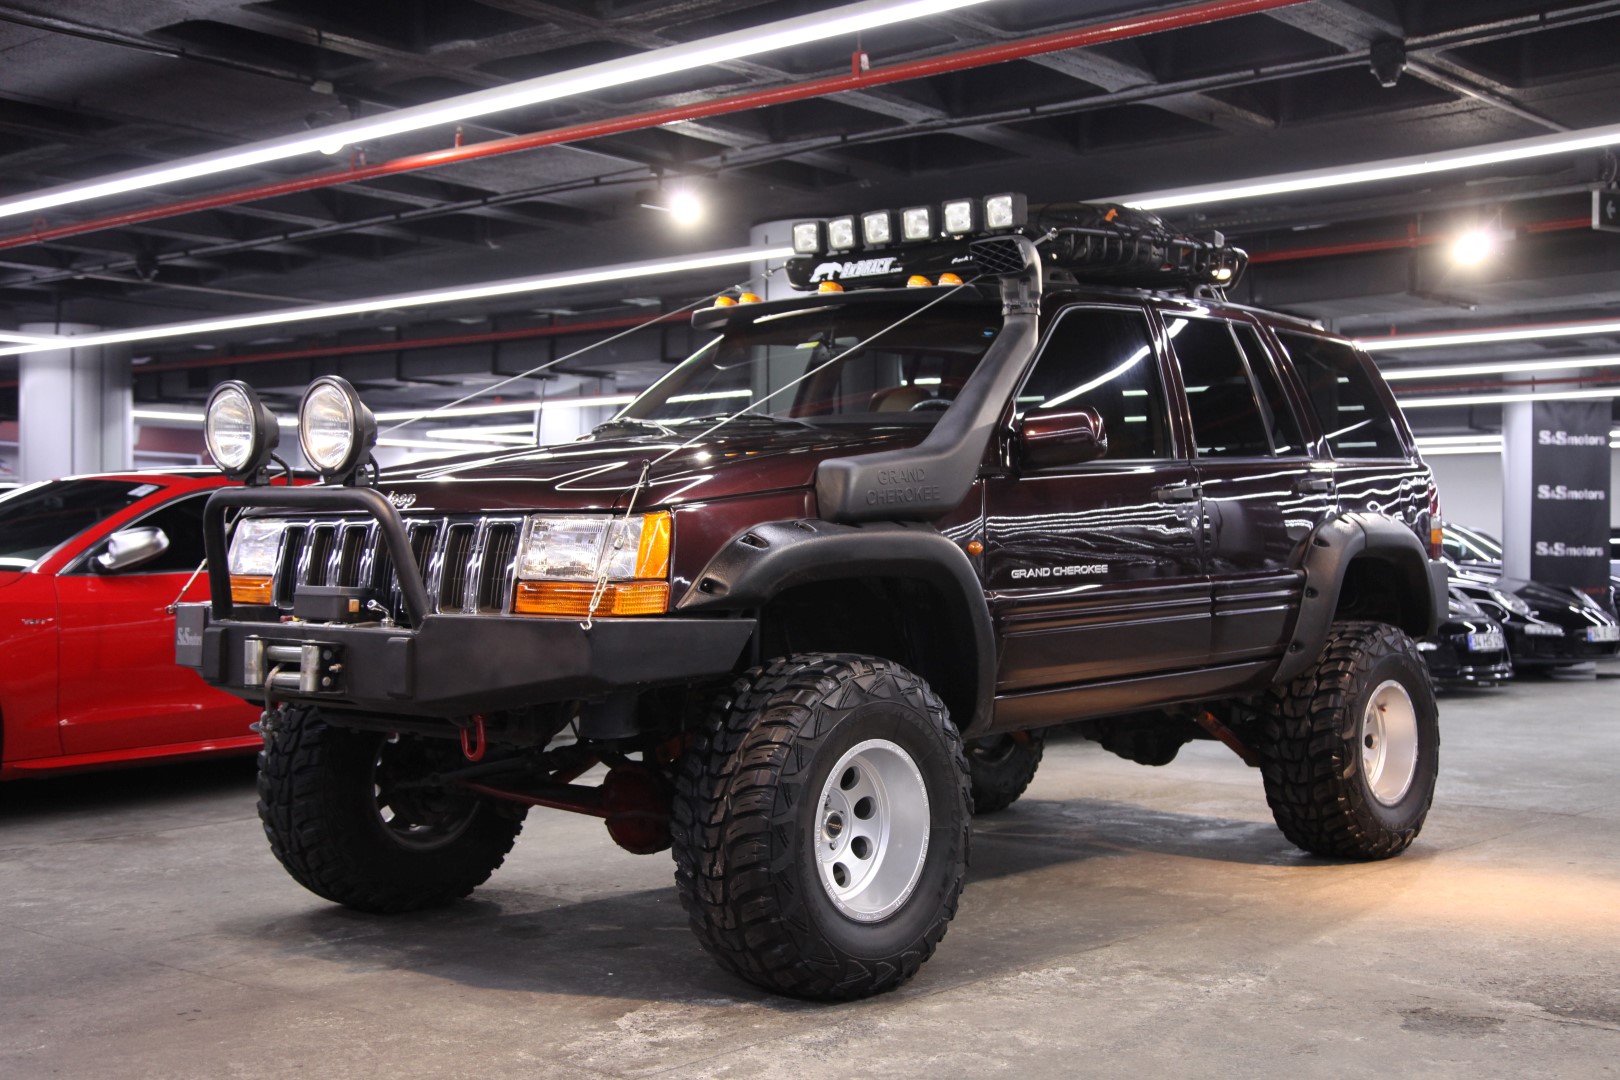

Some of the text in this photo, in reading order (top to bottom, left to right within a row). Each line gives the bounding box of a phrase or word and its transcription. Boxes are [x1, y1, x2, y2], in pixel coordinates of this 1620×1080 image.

[877, 468, 925, 485] GRAND
[866, 485, 941, 505] CHEROKEE
[1011, 564, 1109, 579] GRAND CHEROKEE
